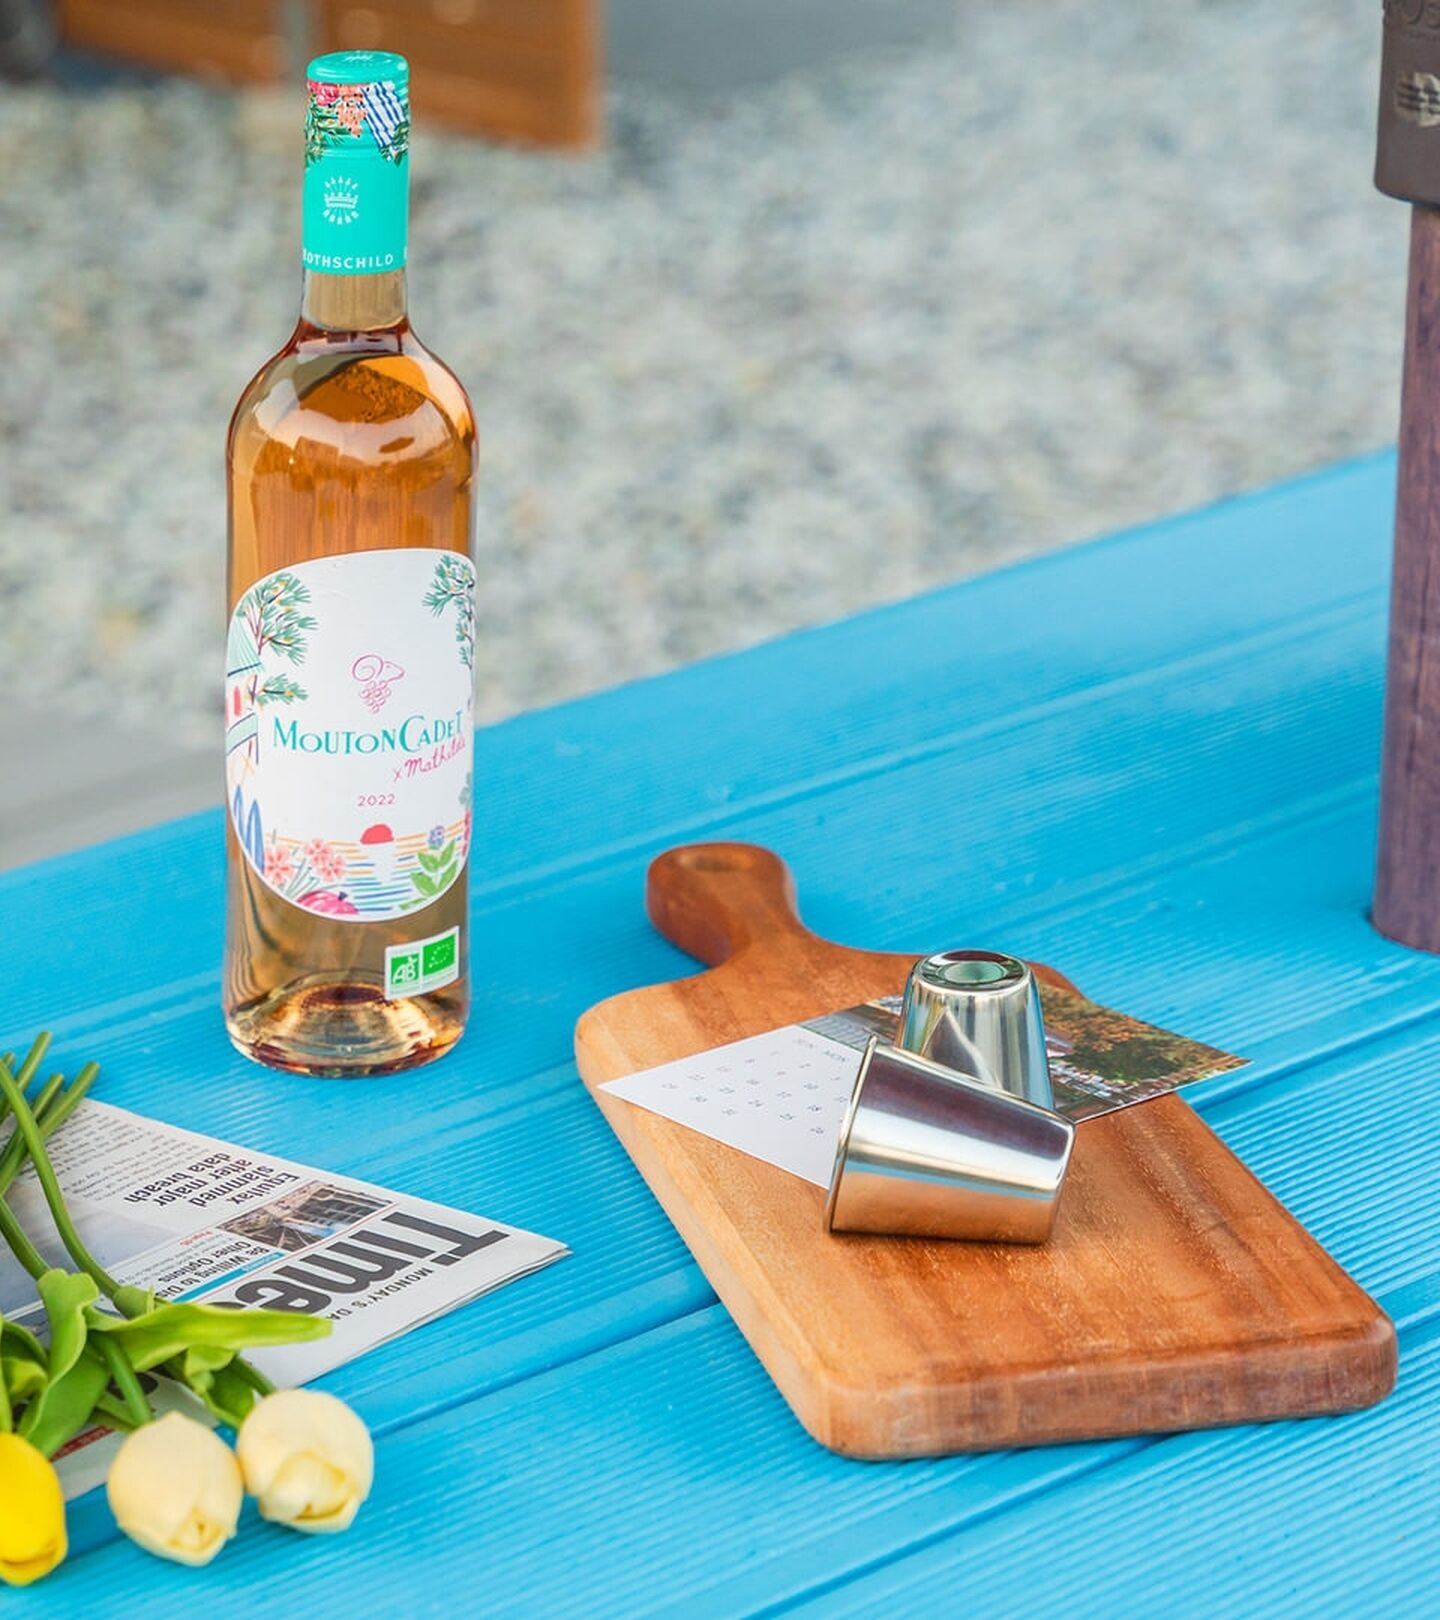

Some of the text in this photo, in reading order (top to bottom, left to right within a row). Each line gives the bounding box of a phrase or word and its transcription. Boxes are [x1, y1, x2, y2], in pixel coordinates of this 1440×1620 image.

[357, 793, 396, 807] 2022
[188, 1152, 231, 1173] data
[211, 1158, 252, 1180] after
[123, 1172, 195, 1204] breach
[152, 1178, 209, 1207] major
[188, 1165, 275, 1208] slammed
[226, 1172, 300, 1205] Equifax
[155, 1284, 184, 1297] Dis
[325, 1267, 434, 1321] MONDAY'S DA
